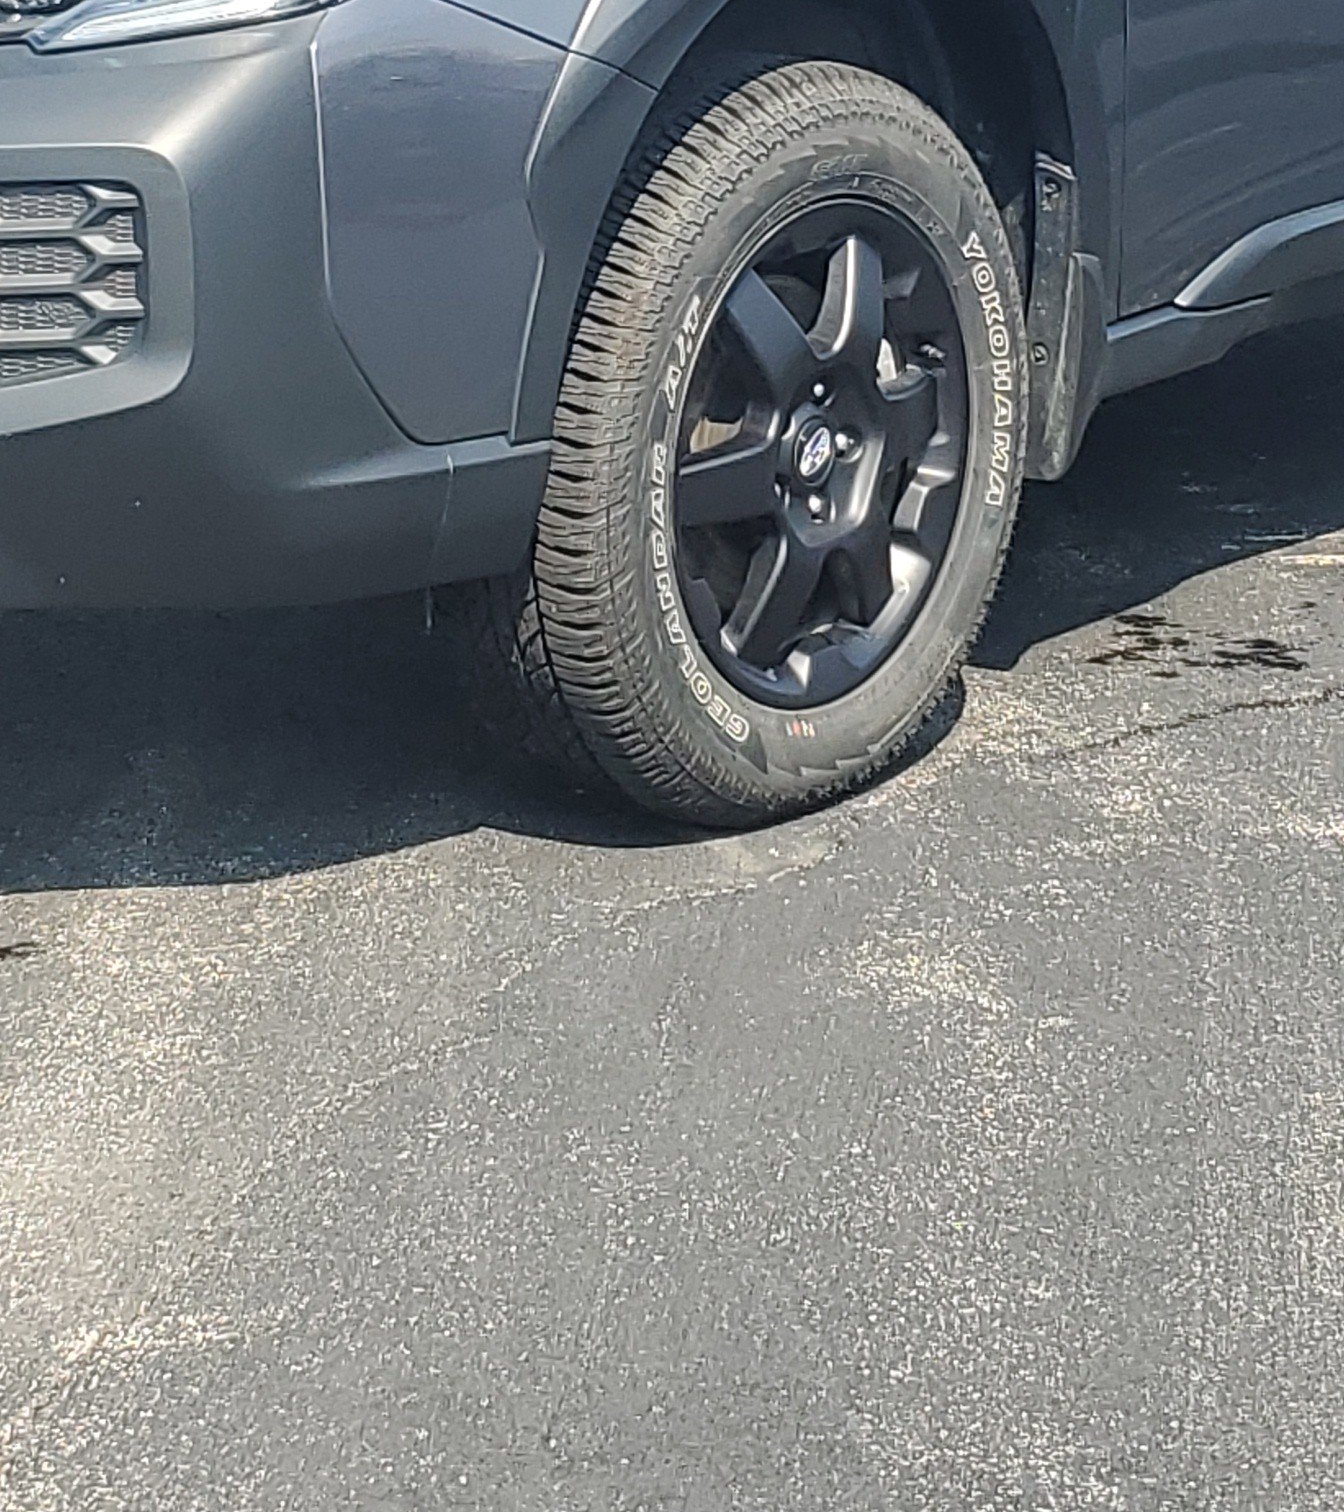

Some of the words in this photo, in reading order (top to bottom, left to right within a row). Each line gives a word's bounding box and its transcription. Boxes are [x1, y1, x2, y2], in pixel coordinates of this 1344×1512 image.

[662, 295, 701, 411] A/T
[960, 231, 1012, 507] YOKOHAMA
[651, 443, 751, 743] GEOLANDAR
